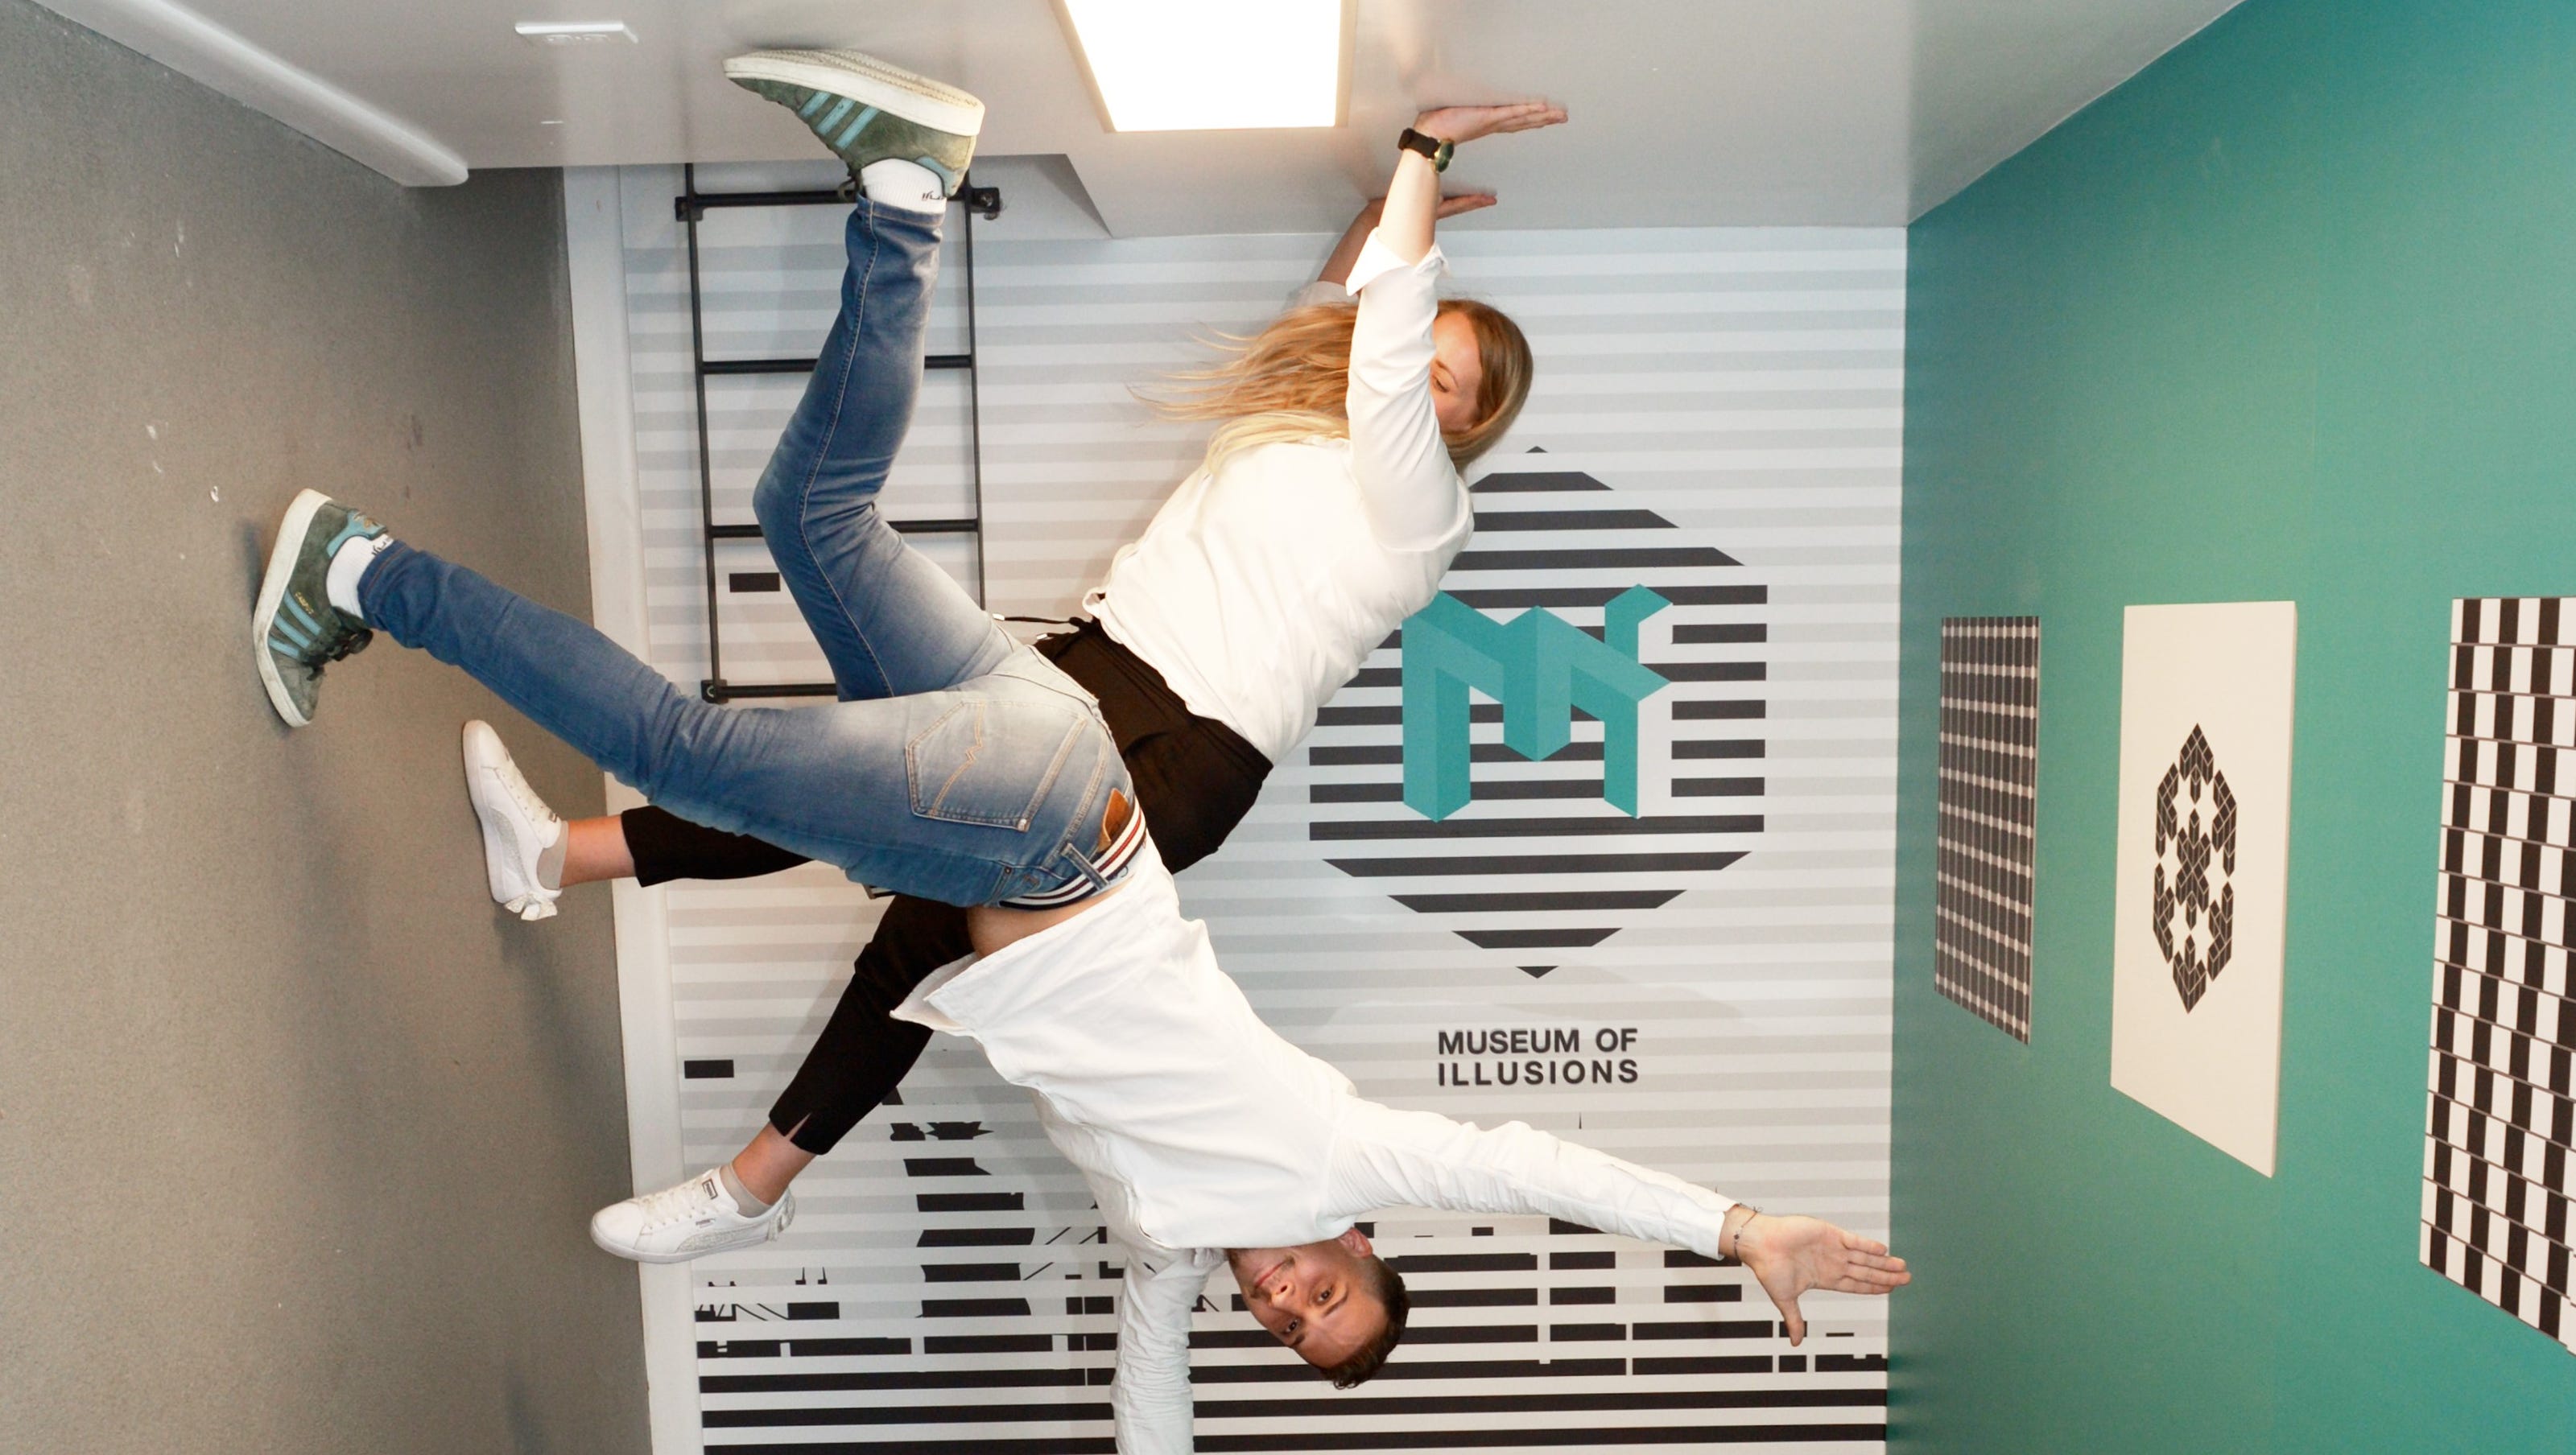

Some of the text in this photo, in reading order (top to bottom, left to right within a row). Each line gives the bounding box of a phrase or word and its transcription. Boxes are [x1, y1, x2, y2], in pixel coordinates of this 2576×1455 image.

[1438, 1028, 1638, 1055] MUSEUM OF
[1438, 1058, 1638, 1086] ILLUSIONS
